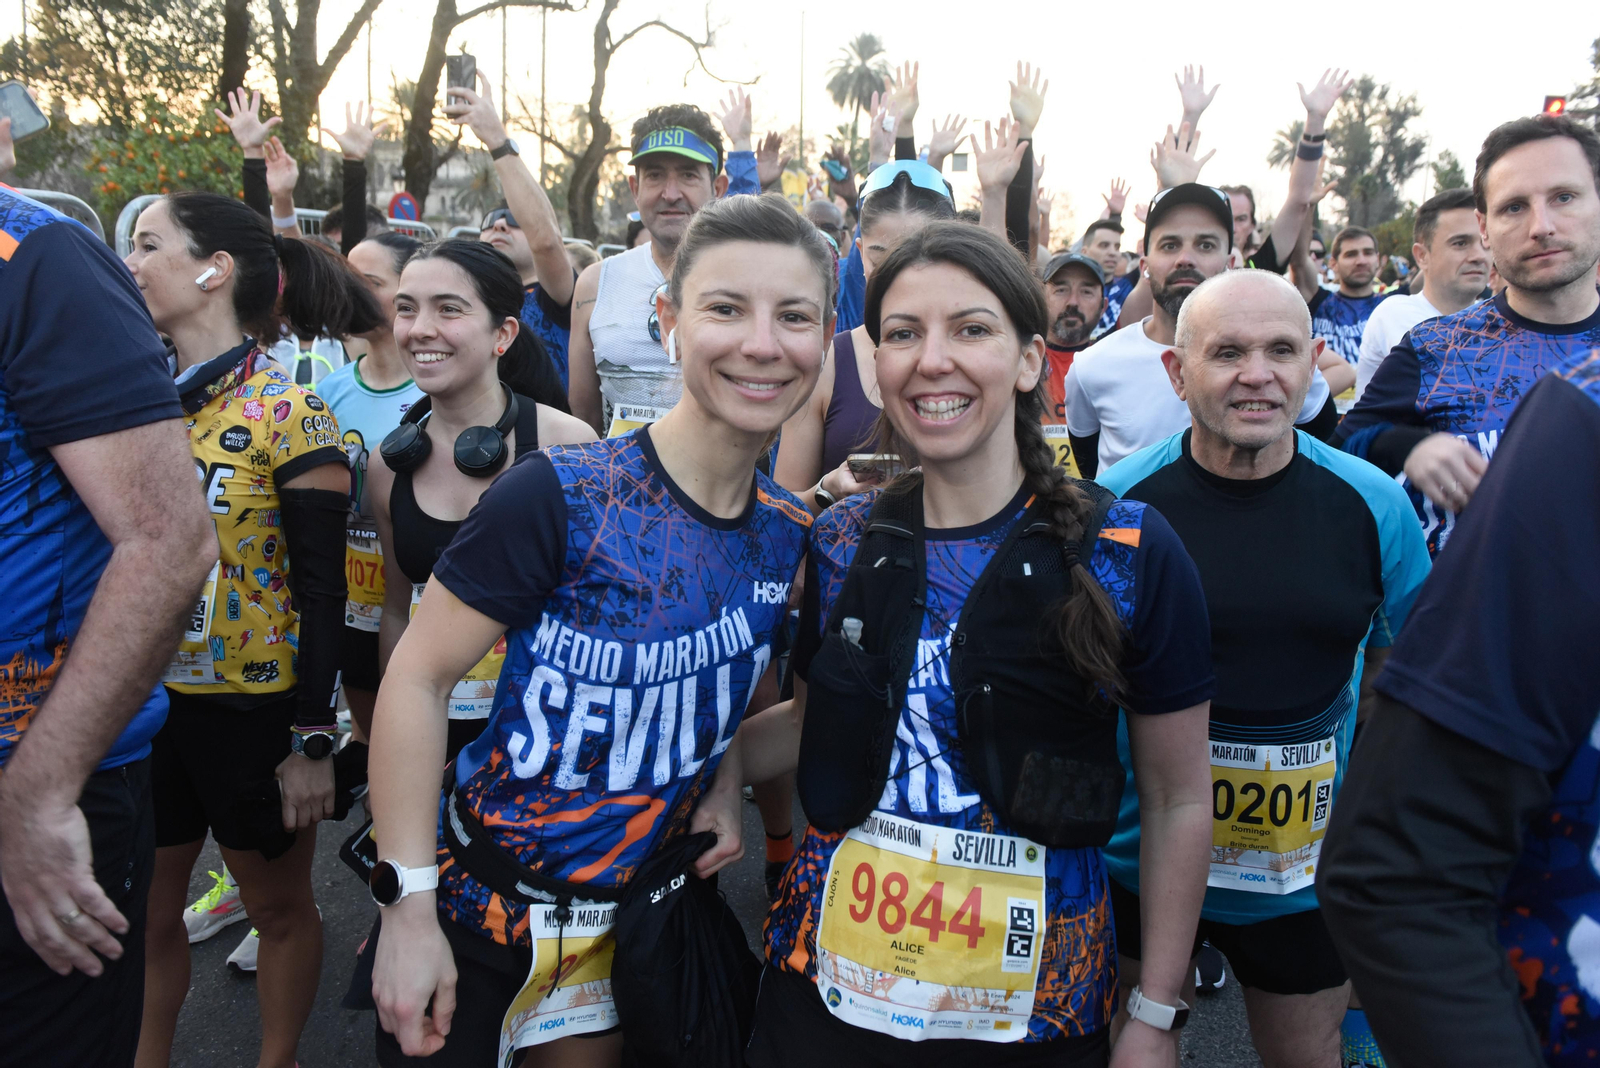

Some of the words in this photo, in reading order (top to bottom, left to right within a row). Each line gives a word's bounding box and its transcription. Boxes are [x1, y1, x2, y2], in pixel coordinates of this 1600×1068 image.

[224, 439, 246, 448] WILLIS
[226, 432, 248, 441] BRUSH
[753, 581, 791, 604] HOK
[530, 612, 624, 683] MEDIO
[633, 606, 754, 685] MARATÓN
[242, 659, 279, 676] NEVER
[243, 671, 279, 683] STOP
[455, 704, 476, 712] HOKA
[1212, 744, 1257, 763] MARATÓN
[1281, 742, 1321, 767] SEVILLA
[1231, 825, 1271, 837] Domingo
[877, 819, 921, 848] MARATÓN
[952, 833, 1017, 868] SEVILLA
[1240, 872, 1266, 883] HOKA
[828, 877, 838, 907] CAJÓN
[849, 862, 986, 950] 9844
[577, 906, 617, 928] MARATÓ
[890, 940, 925, 955] ALICE
[895, 955, 917, 965] FAGEDE
[894, 965, 916, 977] Alice
[539, 1017, 566, 1032] HOKA
[891, 1012, 925, 1030] HOKA
